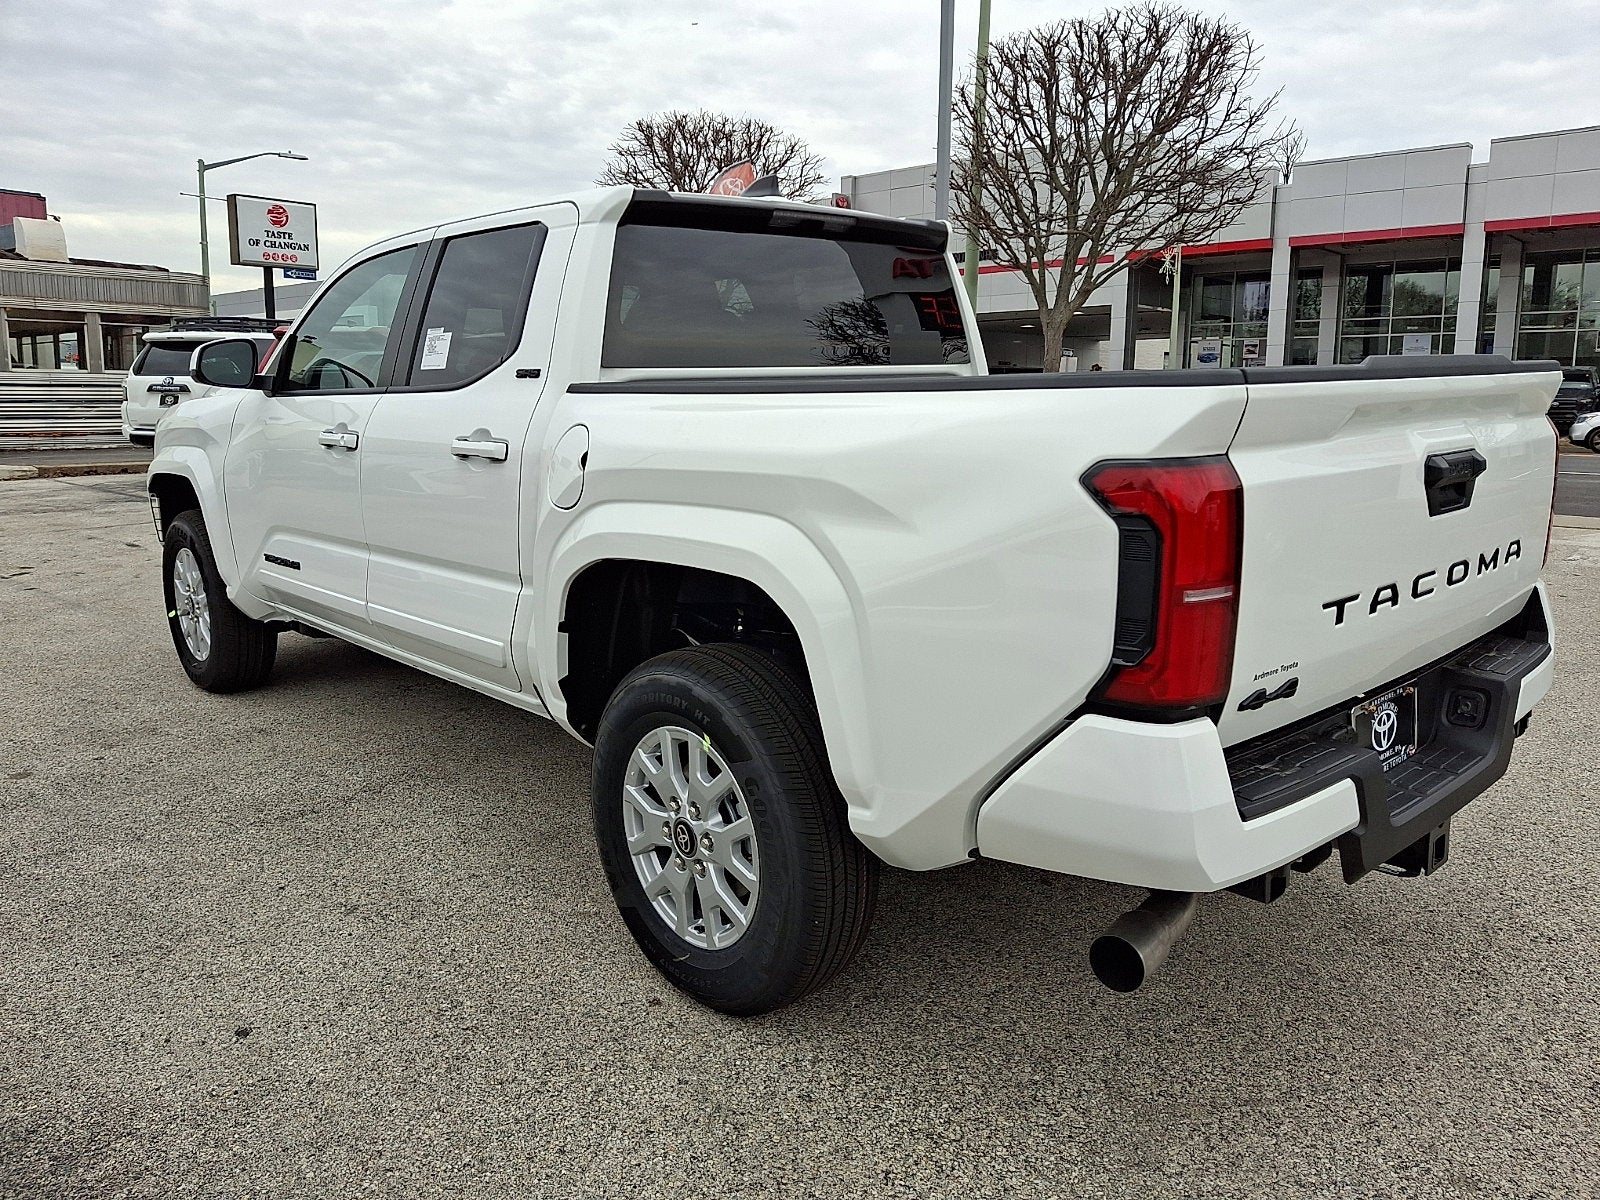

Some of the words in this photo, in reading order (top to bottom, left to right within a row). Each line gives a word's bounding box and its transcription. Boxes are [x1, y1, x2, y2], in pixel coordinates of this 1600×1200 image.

[264, 230, 294, 240] TASTE
[248, 238, 261, 247] OF
[263, 240, 310, 252] CHANG'AN
[1321, 538, 1522, 626] TACOMA
[1252, 667, 1279, 682] Ardmore
[1279, 660, 1299, 673] Toyota
[1389, 753, 1408, 769] TOYOTA
